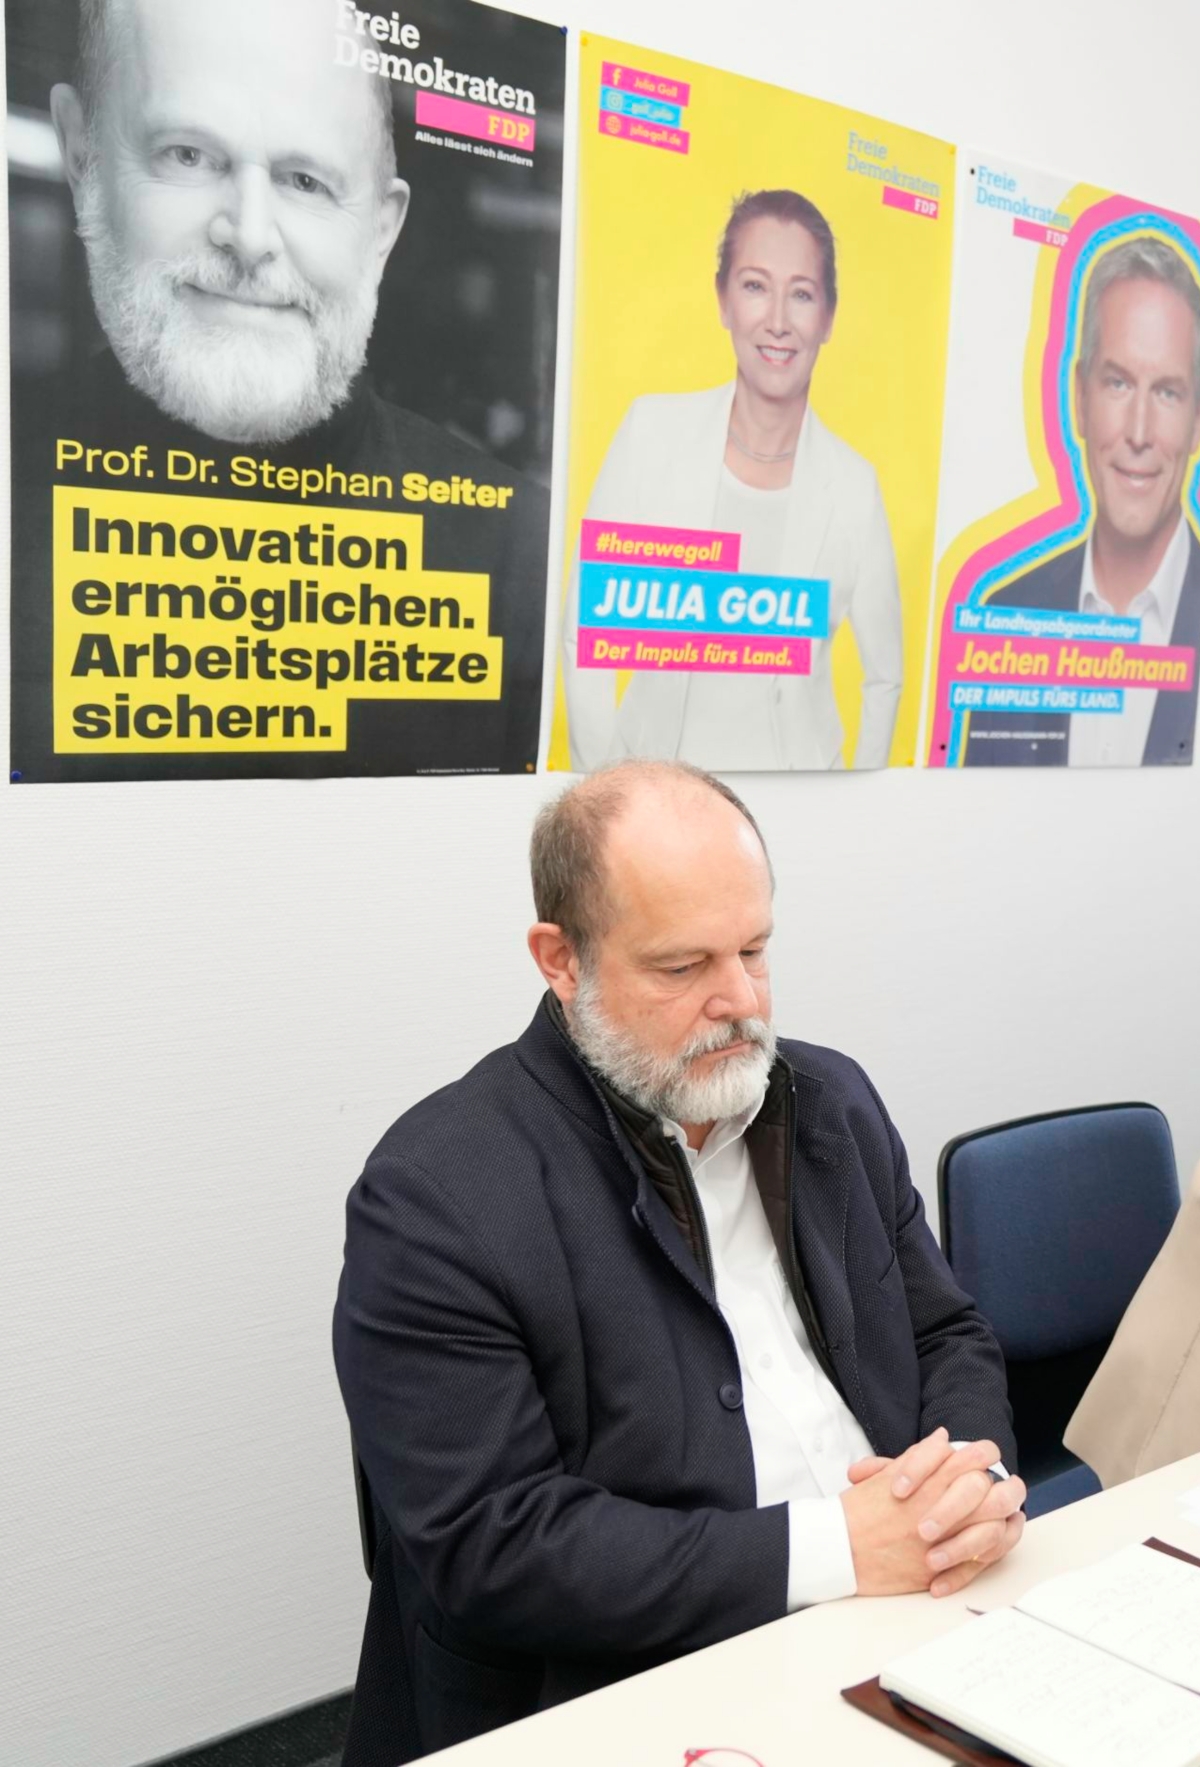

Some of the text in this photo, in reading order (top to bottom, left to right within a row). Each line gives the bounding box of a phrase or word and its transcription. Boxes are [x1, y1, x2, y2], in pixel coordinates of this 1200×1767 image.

[335, 0, 420, 49] Freie
[333, 33, 536, 115] Demokraten
[415, 130, 534, 167] Alles lässt sich ändern
[488, 115, 530, 142] FDP
[848, 131, 888, 160] Freie
[846, 153, 941, 198] Demokraten
[977, 165, 1016, 192] Freie
[914, 198, 937, 215] FDP
[976, 186, 1070, 229] Demokraten
[1046, 230, 1068, 247] FDP
[55, 439, 513, 508] Prof. Dr. Stephan Seiter
[72, 506, 409, 571] Innovation
[596, 533, 723, 565] #herewegoll
[71, 575, 475, 632] ermöglichen.
[593, 578, 813, 627] JULIA GOLL
[959, 609, 1138, 639] Ihr Landtagsabgeordneter
[70, 633, 489, 690] Arbeitsplätze
[593, 639, 792, 667] Der Impuls fürs Land.
[956, 641, 1187, 682] Jochen Haußmann
[72, 693, 332, 739] sichern.
[953, 685, 1121, 709] DER IMPULS FÜRS LAND.
